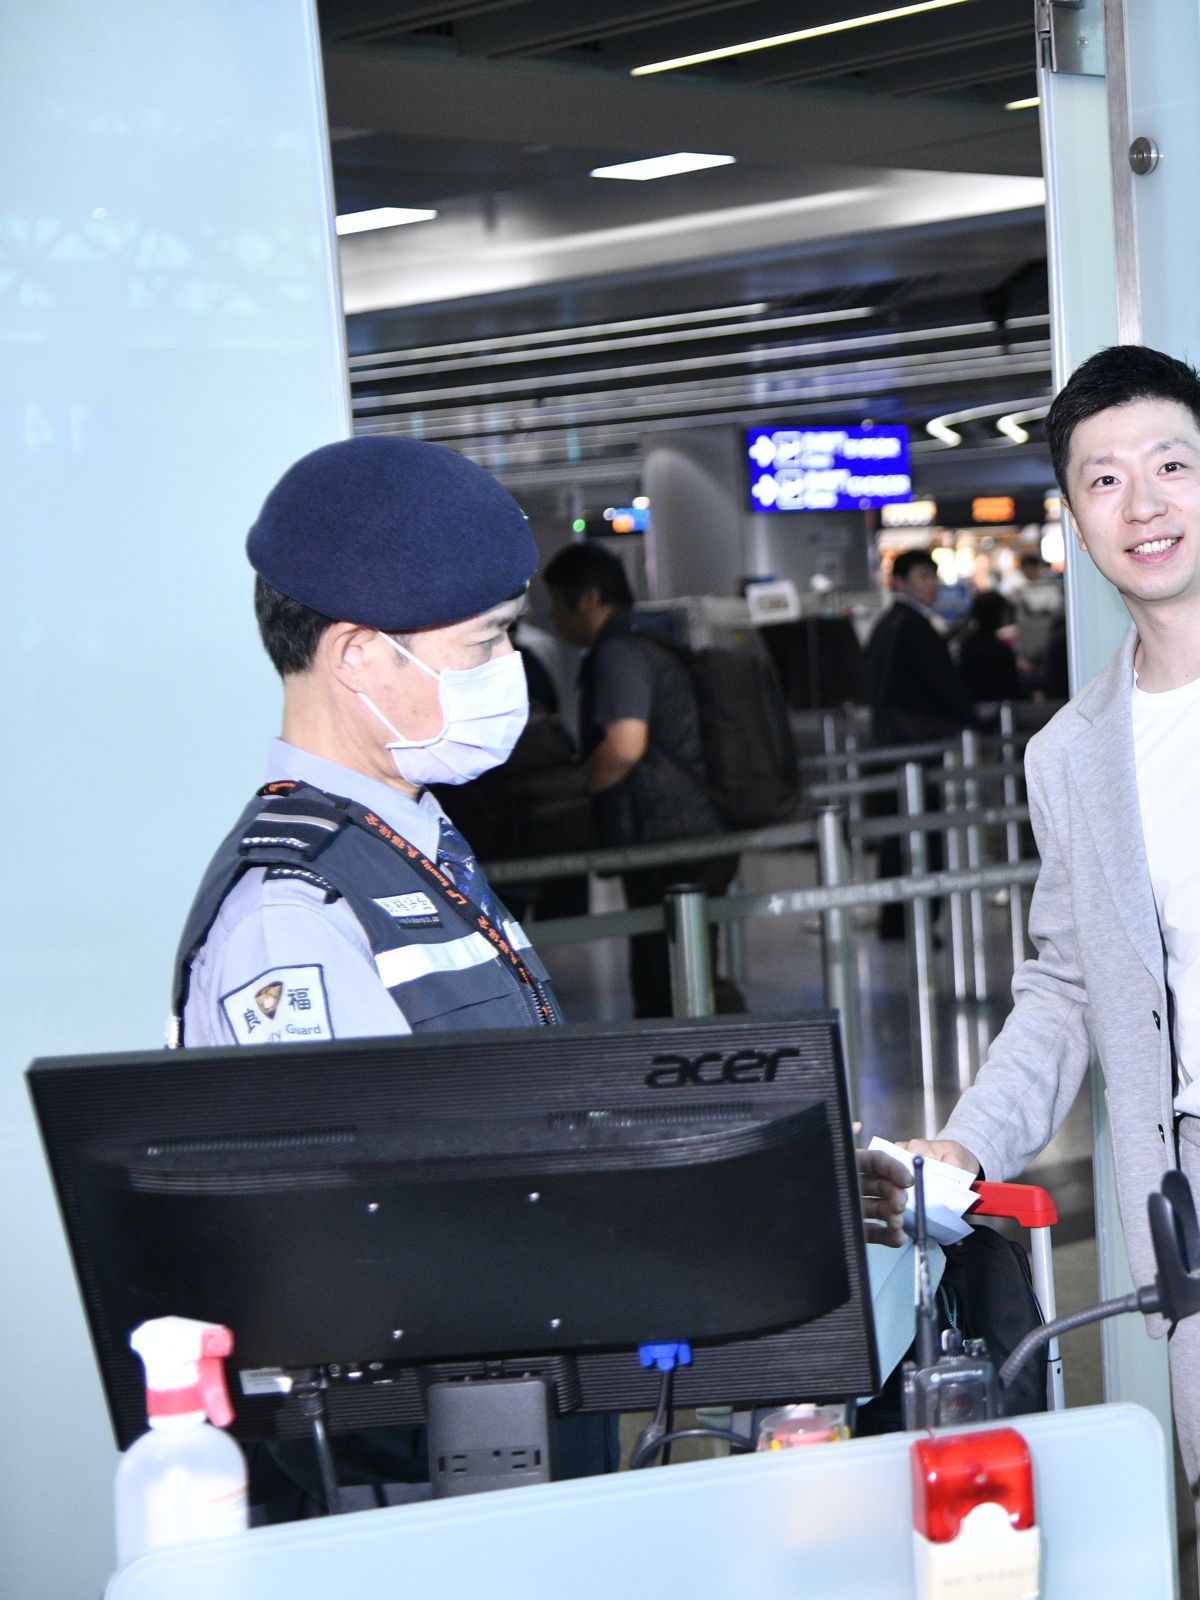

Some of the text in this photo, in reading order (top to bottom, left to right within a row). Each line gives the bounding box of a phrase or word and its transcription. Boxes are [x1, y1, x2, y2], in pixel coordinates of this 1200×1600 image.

[287, 987, 311, 1012] 福
[285, 1023, 322, 1035] Guard
[643, 1047, 800, 1089] acer
